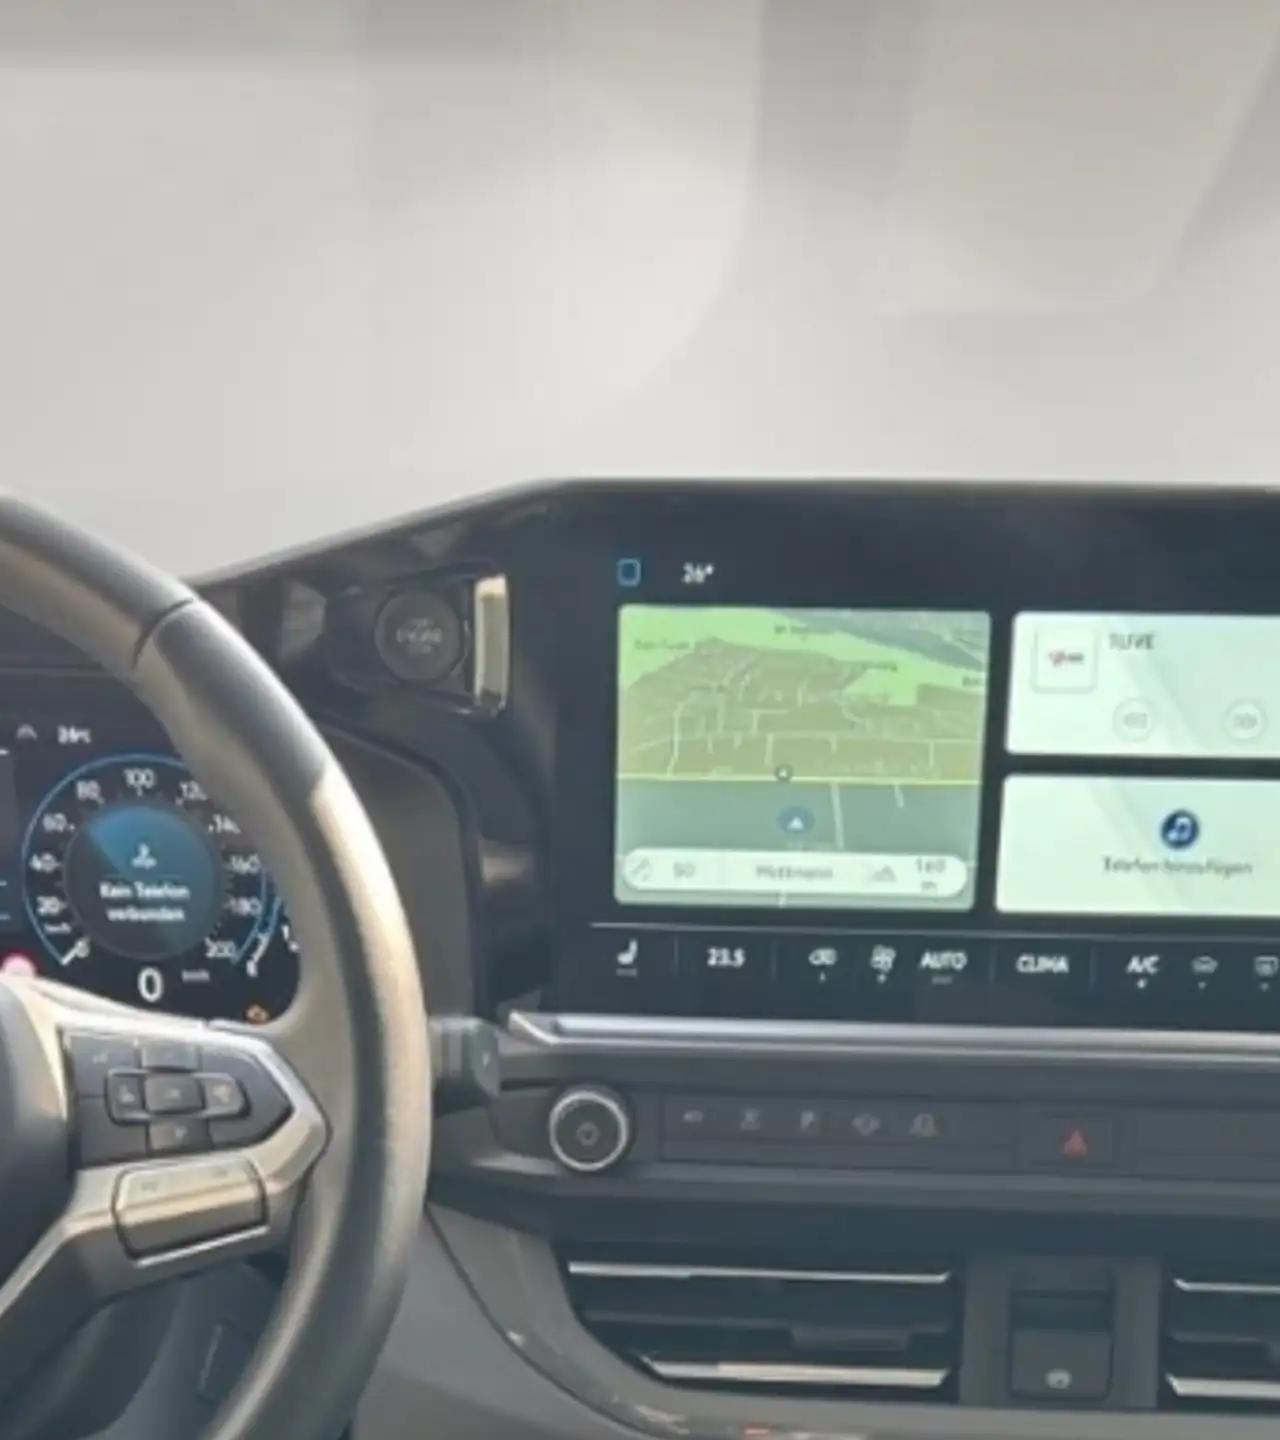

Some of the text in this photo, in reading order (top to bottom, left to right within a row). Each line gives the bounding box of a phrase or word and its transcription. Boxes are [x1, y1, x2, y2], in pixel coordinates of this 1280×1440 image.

[123, 767, 155, 788] 100
[135, 881, 190, 900] Telefon
[106, 905, 186, 922] verbunden
[706, 947, 746, 968] 23.5
[920, 949, 969, 970] AUTO
[1015, 954, 1071, 974] CLIMA
[1125, 955, 1161, 975] A/C
[137, 966, 163, 1002] 0
